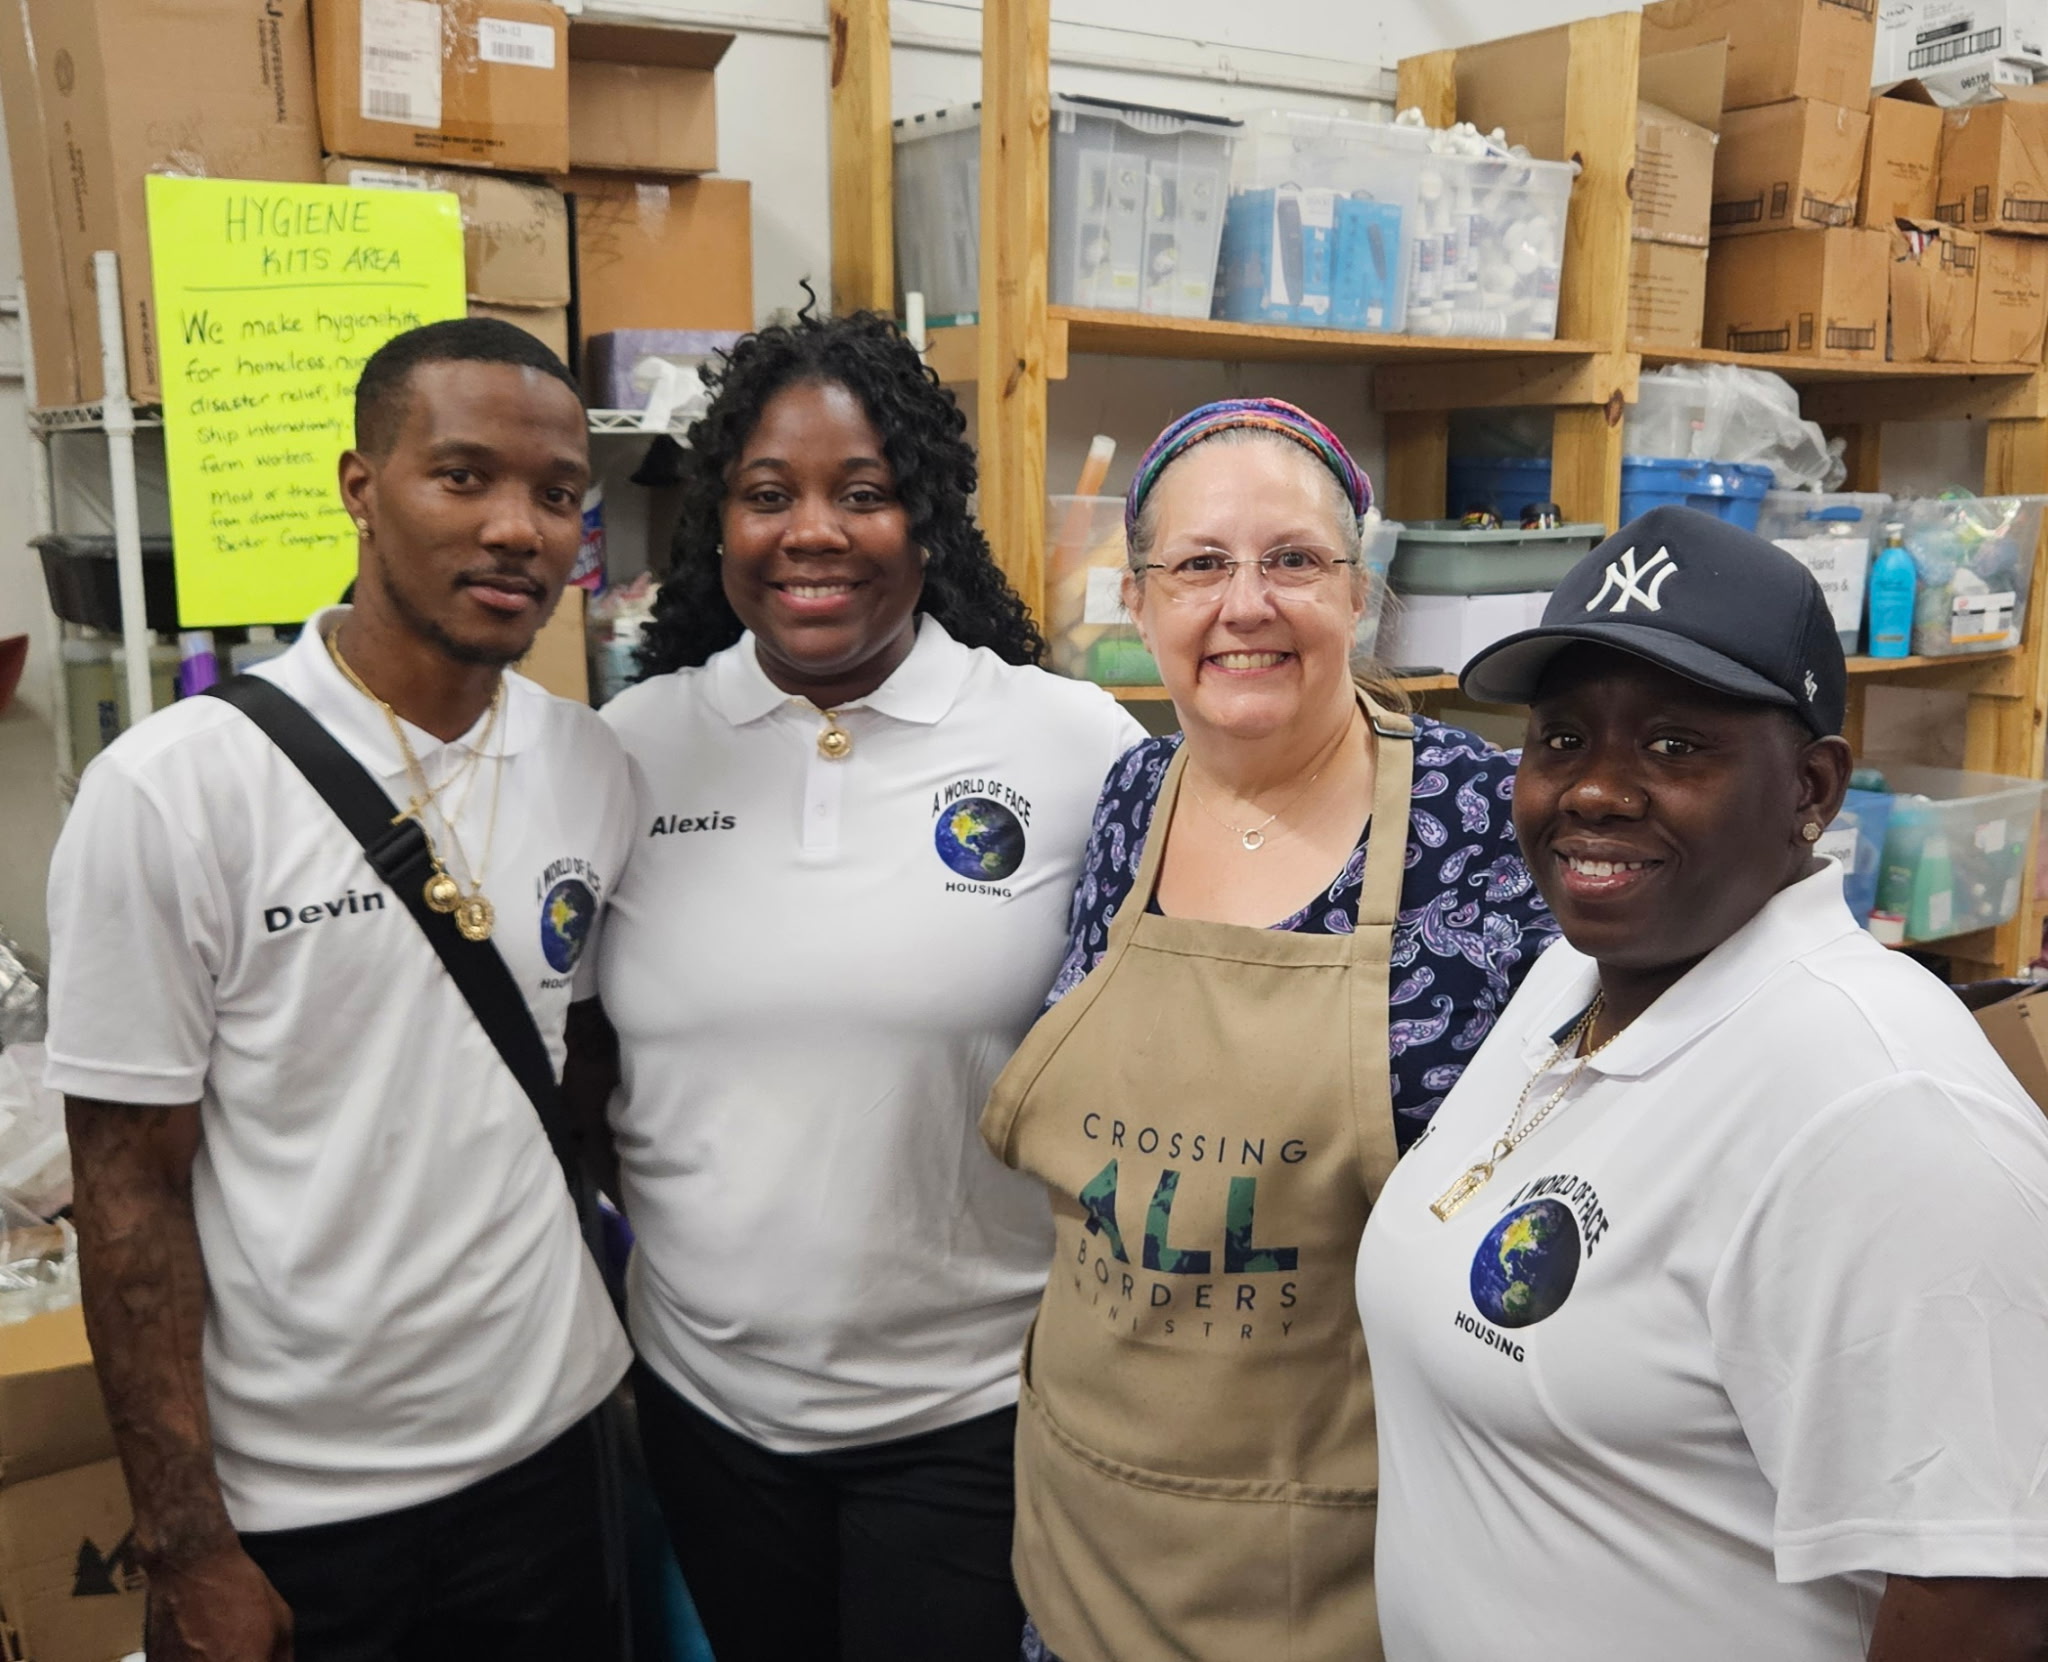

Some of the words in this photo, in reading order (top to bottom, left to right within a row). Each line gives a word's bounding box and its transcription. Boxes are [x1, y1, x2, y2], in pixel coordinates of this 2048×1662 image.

[225, 195, 372, 243] HYGIENE
[262, 246, 331, 277] KITS
[344, 246, 400, 273] AREA
[180, 307, 224, 345] We
[242, 313, 302, 339] make
[185, 358, 221, 383] for
[190, 393, 270, 417] disaster
[198, 425, 239, 446] Ship
[200, 452, 244, 475] farm
[210, 487, 254, 505] Most
[210, 509, 241, 529] from
[1586, 545, 1679, 613] NY
[931, 790, 942, 819] A
[944, 778, 985, 805] WORLD
[988, 780, 1003, 798] OF
[1005, 786, 1032, 828] FACE
[648, 810, 737, 839] Alexis
[543, 856, 573, 891] WORLD
[573, 857, 585, 876] OF
[945, 881, 1013, 899] HOUSING
[263, 889, 386, 933] Devin
[1083, 1112, 1308, 1166] CROSSING
[1499, 1180, 1532, 1214] A
[1521, 1173, 1579, 1202] WORLD
[1571, 1180, 1592, 1206] OF
[1078, 1157, 1299, 1275] ALL
[1577, 1191, 1610, 1260] FACE
[1077, 1238, 1299, 1312] BORDERS
[1074, 1276, 1294, 1341] MINISTRY
[1453, 1310, 1526, 1364] HOUSING
